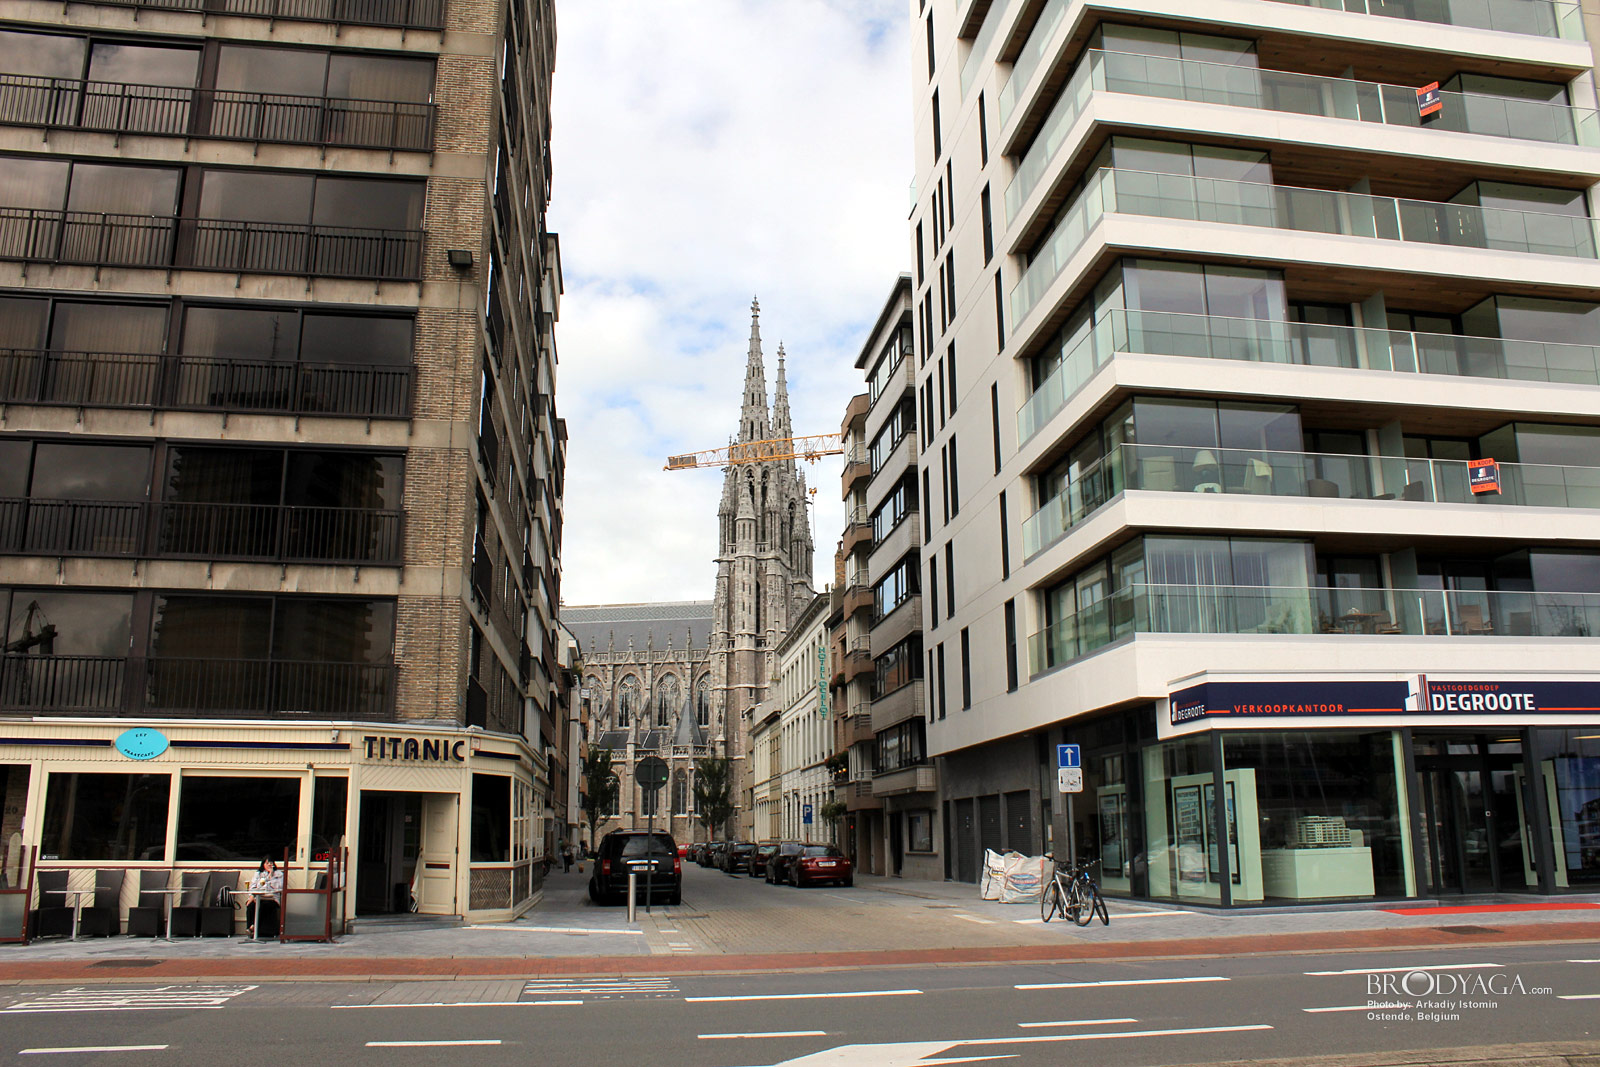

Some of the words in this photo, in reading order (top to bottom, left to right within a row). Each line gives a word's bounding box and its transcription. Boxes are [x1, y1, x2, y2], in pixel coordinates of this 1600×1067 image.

[818, 647, 826, 679] HOTEL
[818, 681, 828, 720] OCELOT
[1233, 704, 1344, 713] VERKOOPKANTOOR
[1432, 693, 1535, 711] DEGROOTE
[1177, 704, 1205, 720] DEGROOTE
[361, 735, 465, 762] TITANIC
[804, 806, 812, 817] P
